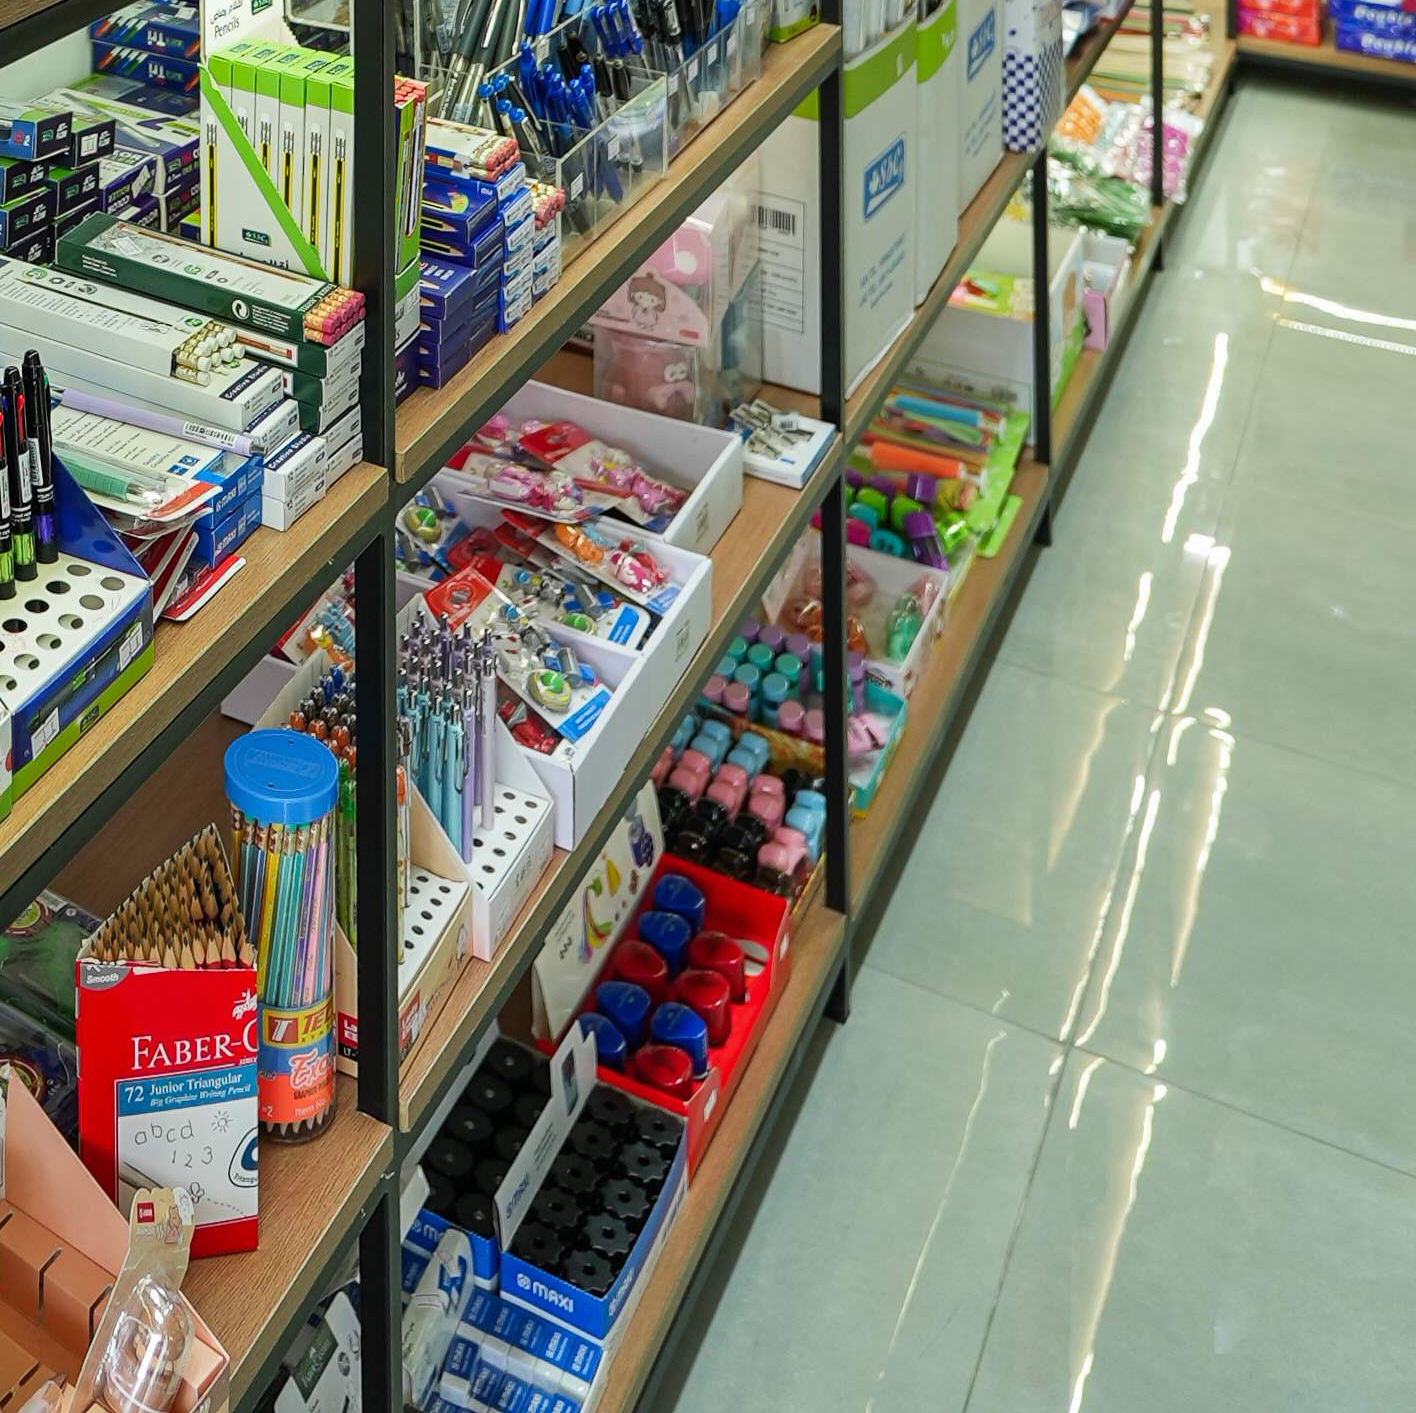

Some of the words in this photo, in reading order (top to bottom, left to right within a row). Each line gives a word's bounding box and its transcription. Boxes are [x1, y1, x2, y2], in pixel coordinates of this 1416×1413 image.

[214, 17, 240, 40] Pencils
[86, 972, 120, 985] Smooth
[124, 1085, 145, 1104] 72
[149, 1079, 185, 1096] Junior
[185, 1072, 243, 1091] Triangular
[199, 1087, 227, 1100] Writing
[228, 1083, 252, 1096] Pencil
[533, 1280, 575, 1314] MAXI
